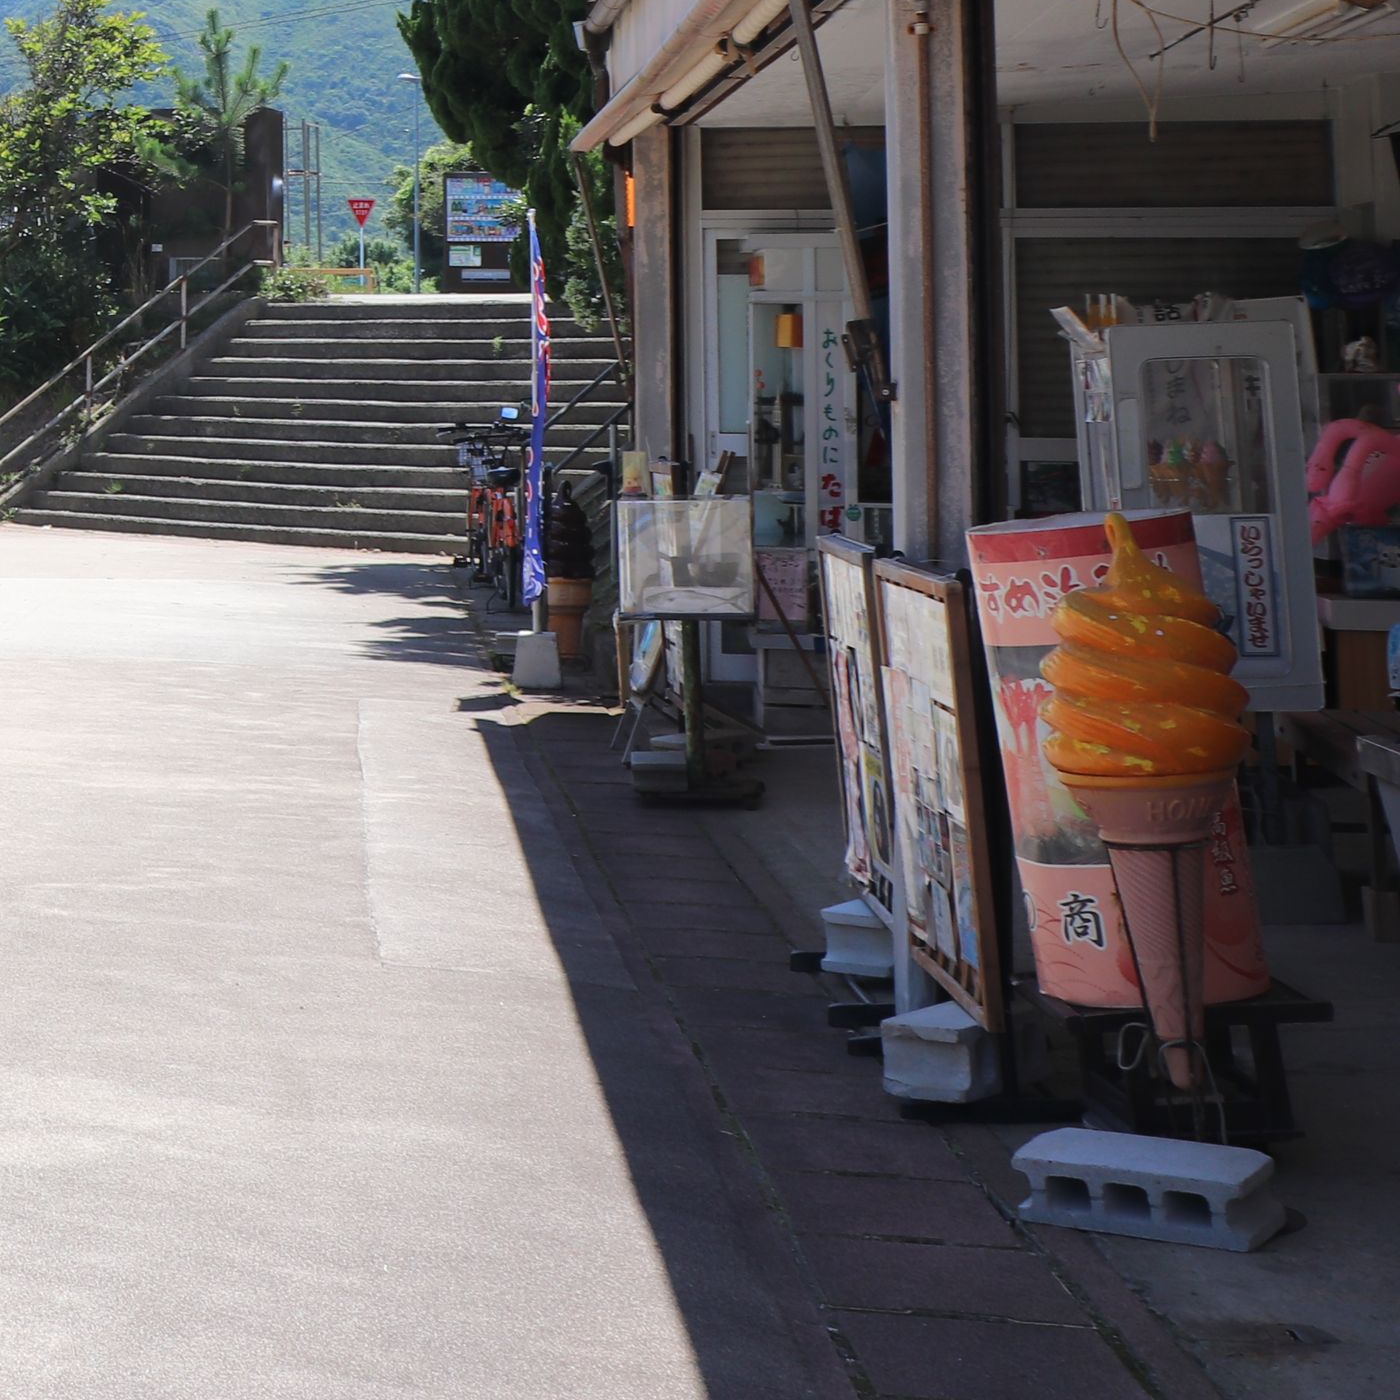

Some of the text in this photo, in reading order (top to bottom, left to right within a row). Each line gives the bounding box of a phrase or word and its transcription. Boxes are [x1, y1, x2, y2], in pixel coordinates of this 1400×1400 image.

[1241, 525, 1269, 648] いらっしゃいませ
